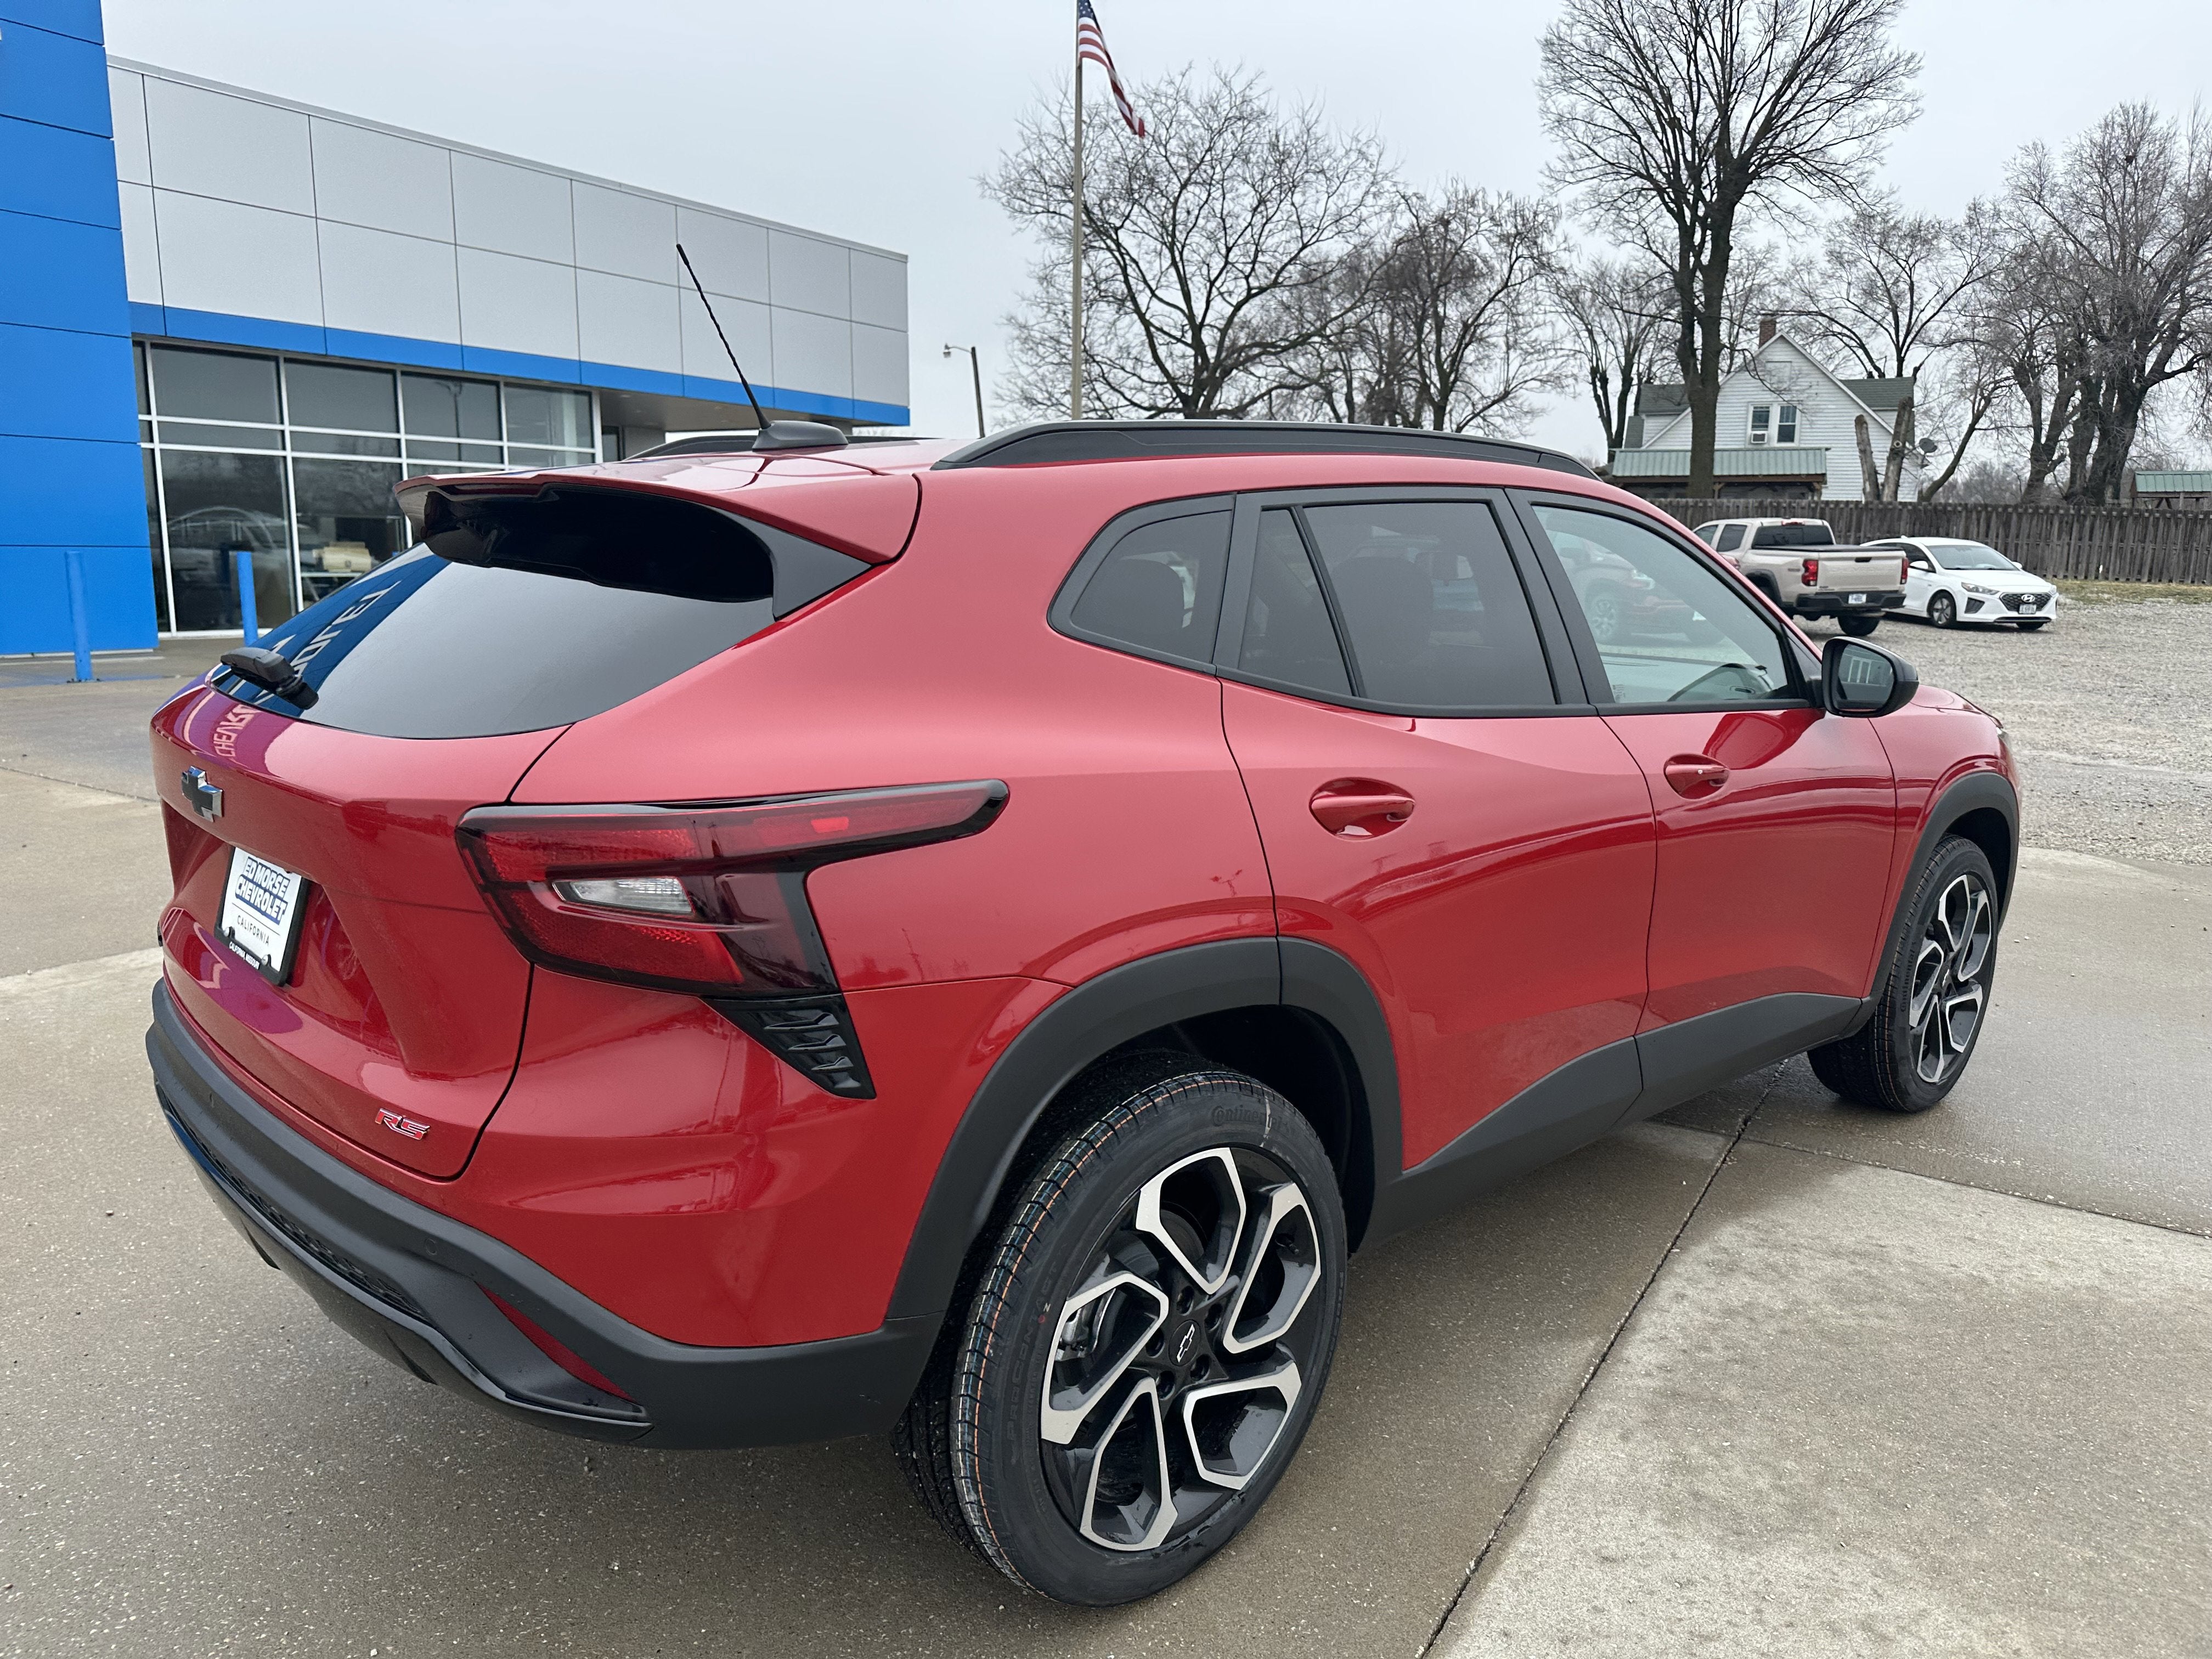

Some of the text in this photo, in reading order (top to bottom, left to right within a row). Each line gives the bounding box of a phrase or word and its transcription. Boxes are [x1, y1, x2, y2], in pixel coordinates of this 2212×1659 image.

[242, 856, 291, 899] ED MORSE
[235, 874, 289, 925] CHEVROLET
[237, 915, 269, 946] CALIFORNIA
[375, 1108, 430, 1140] RS
[1211, 1105, 1283, 1132] Continenal
